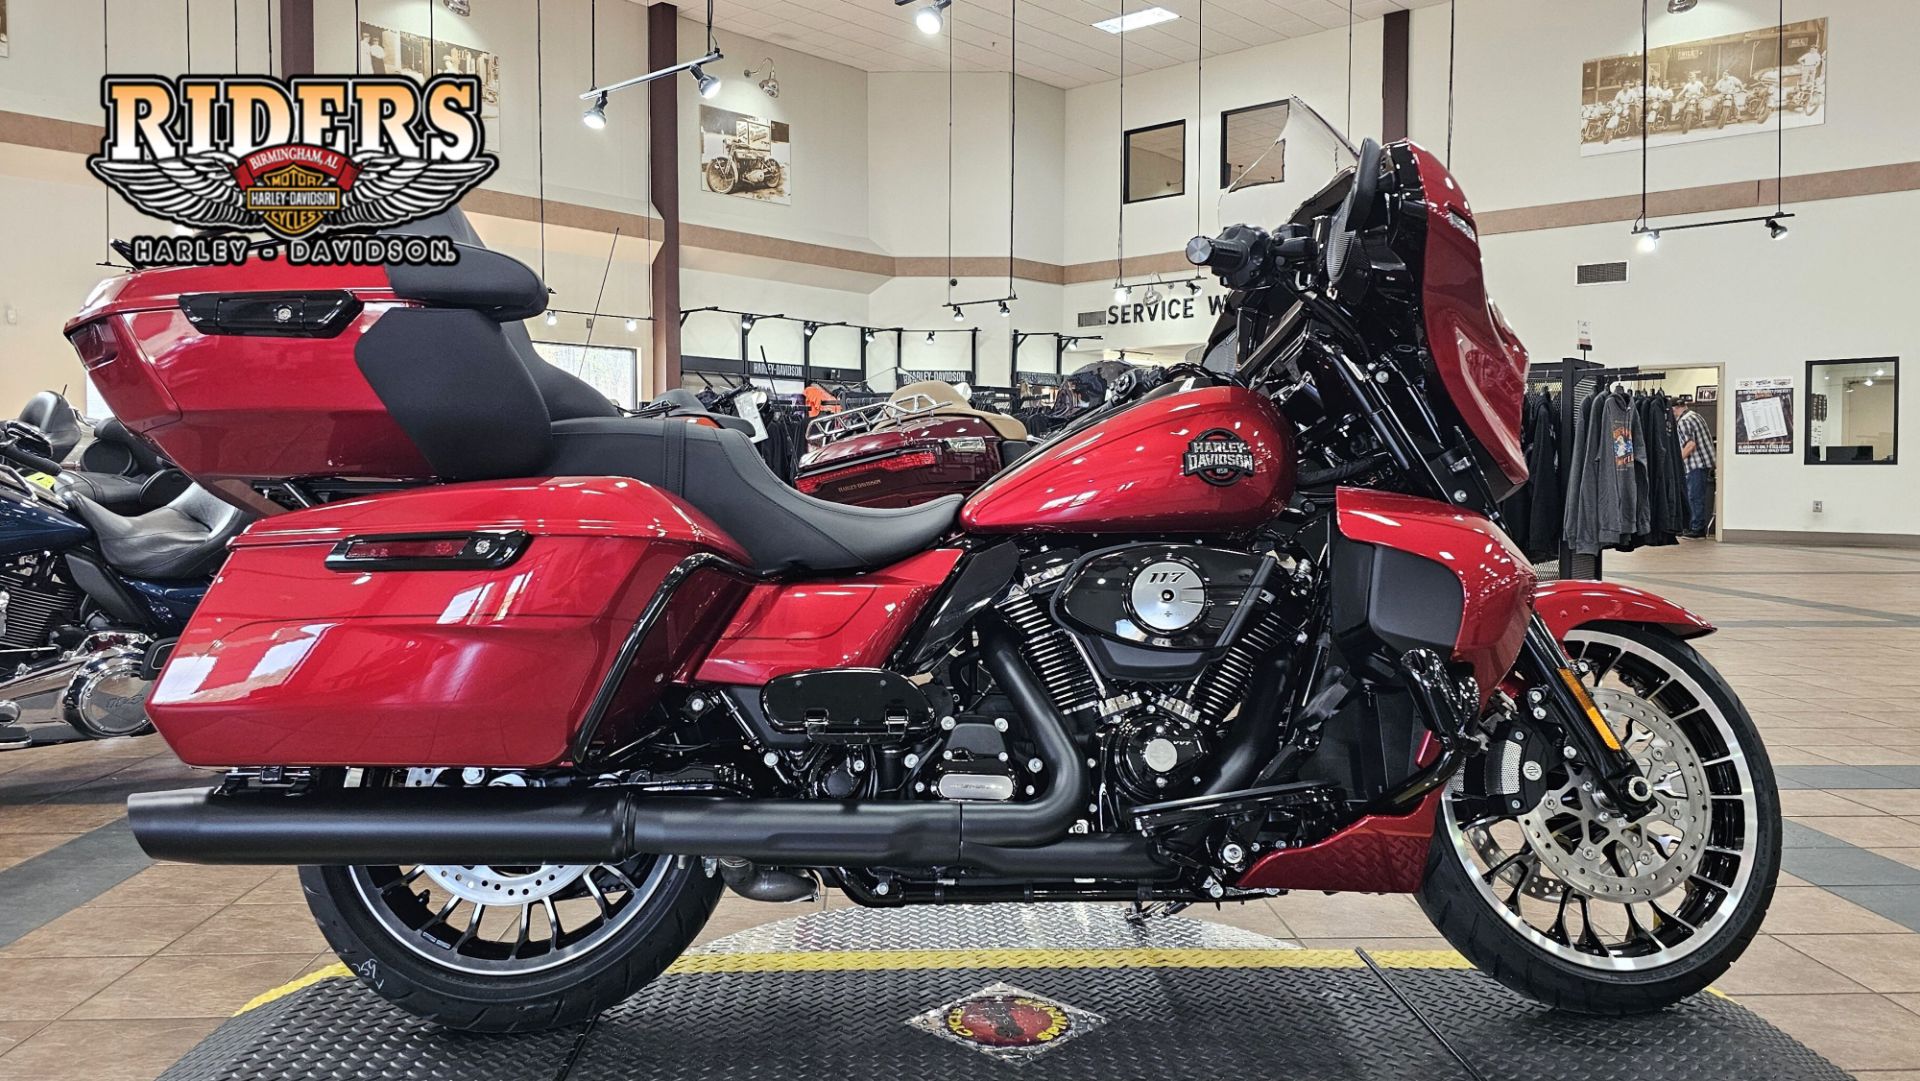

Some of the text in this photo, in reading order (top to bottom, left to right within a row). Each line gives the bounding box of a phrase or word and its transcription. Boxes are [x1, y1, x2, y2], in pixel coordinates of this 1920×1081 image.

[1107, 297, 1195, 325] SERVICE
[1187, 453, 1253, 471] DAVIDSON
[1148, 571, 1187, 584] 117
